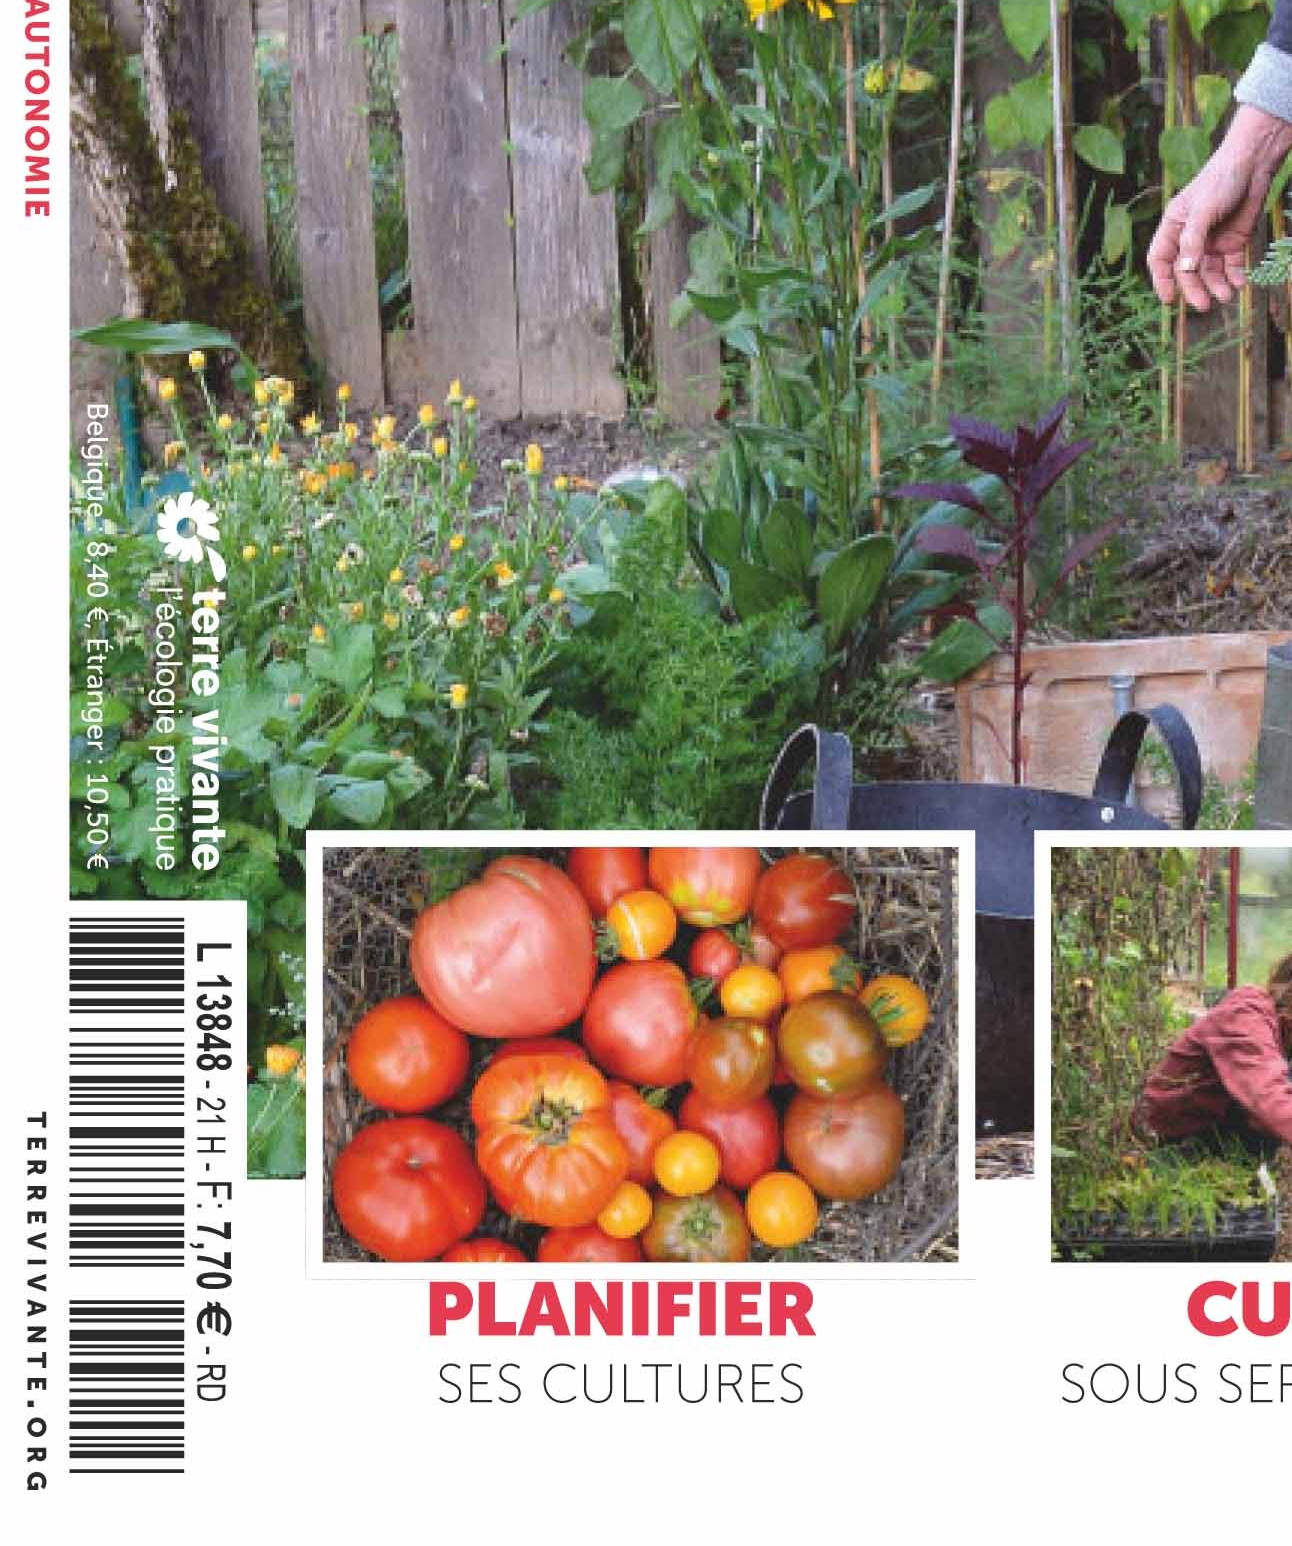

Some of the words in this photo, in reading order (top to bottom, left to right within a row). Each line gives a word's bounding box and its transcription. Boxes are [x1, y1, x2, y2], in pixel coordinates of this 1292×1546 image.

[81, 404, 108, 517] Belgique
[84, 541, 108, 598] 8,40
[192, 588, 226, 696] terre
[81, 639, 114, 751] Étranger
[84, 774, 108, 845] 10,50
[149, 747, 182, 869] pratique
[192, 710, 227, 870] vivante
[87, 854, 108, 868] €
[197, 943, 232, 962] L
[196, 975, 232, 1071] 13848
[197, 1098, 226, 1122] 21
[197, 1137, 226, 1153] H
[190, 1222, 232, 1289] 7,70
[27, 1112, 47, 1490] TERREVIVANTE.ORG
[197, 1301, 232, 1336] €
[430, 1282, 816, 1335] PLANIFIER
[197, 1365, 226, 1401] RD
[439, 1363, 521, 1403] SES
[543, 1363, 803, 1403] CULTURES
[1062, 1363, 1197, 1403] SOUS
